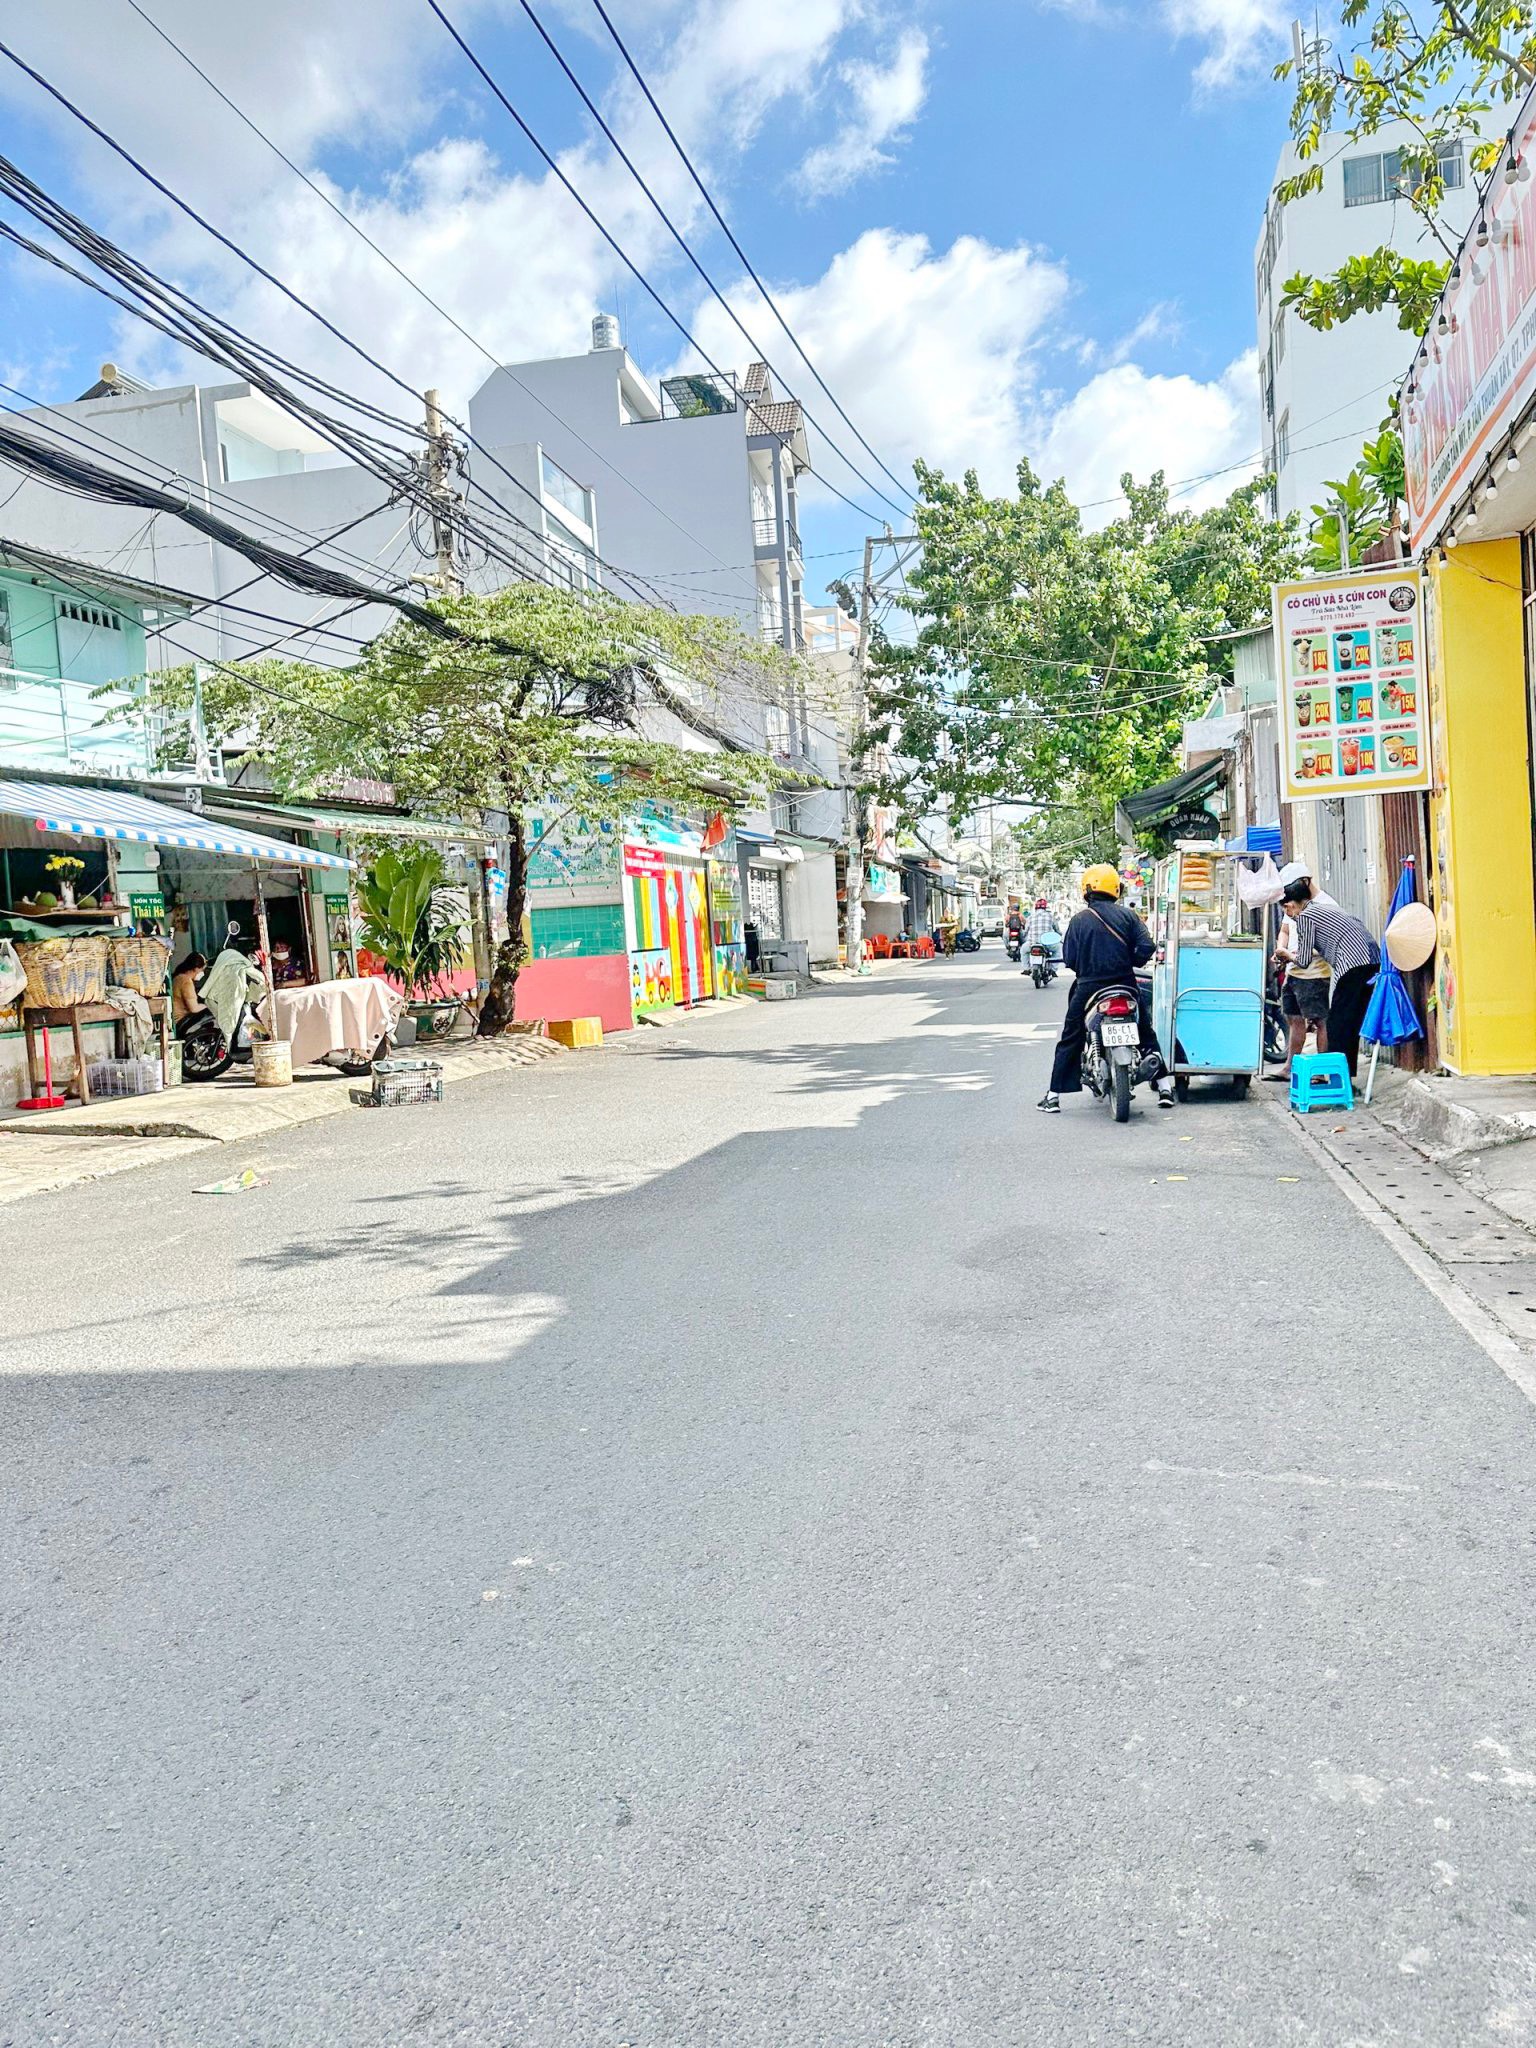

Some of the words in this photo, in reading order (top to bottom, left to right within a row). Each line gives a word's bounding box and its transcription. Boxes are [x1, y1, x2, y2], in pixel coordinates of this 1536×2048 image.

[1287, 597, 1300, 609] CÔ
[1302, 594, 1321, 607] CHỦ
[1322, 594, 1336, 605] VÀ
[1338, 594, 1344, 604] 5
[1345, 590, 1365, 602] CÚN
[1366, 589, 1387, 600] CON
[1355, 646, 1370, 661] 20K
[1398, 641, 1413, 656] 25K
[1313, 651, 1327, 666] 18K
[1358, 698, 1372, 714] 20K
[1401, 694, 1416, 710] 15K
[1315, 703, 1330, 718] 20K
[1360, 752, 1374, 767] 10K
[1403, 747, 1417, 761] 25K
[132, 905, 151, 918] Thái
[153, 905, 165, 918] Hà
